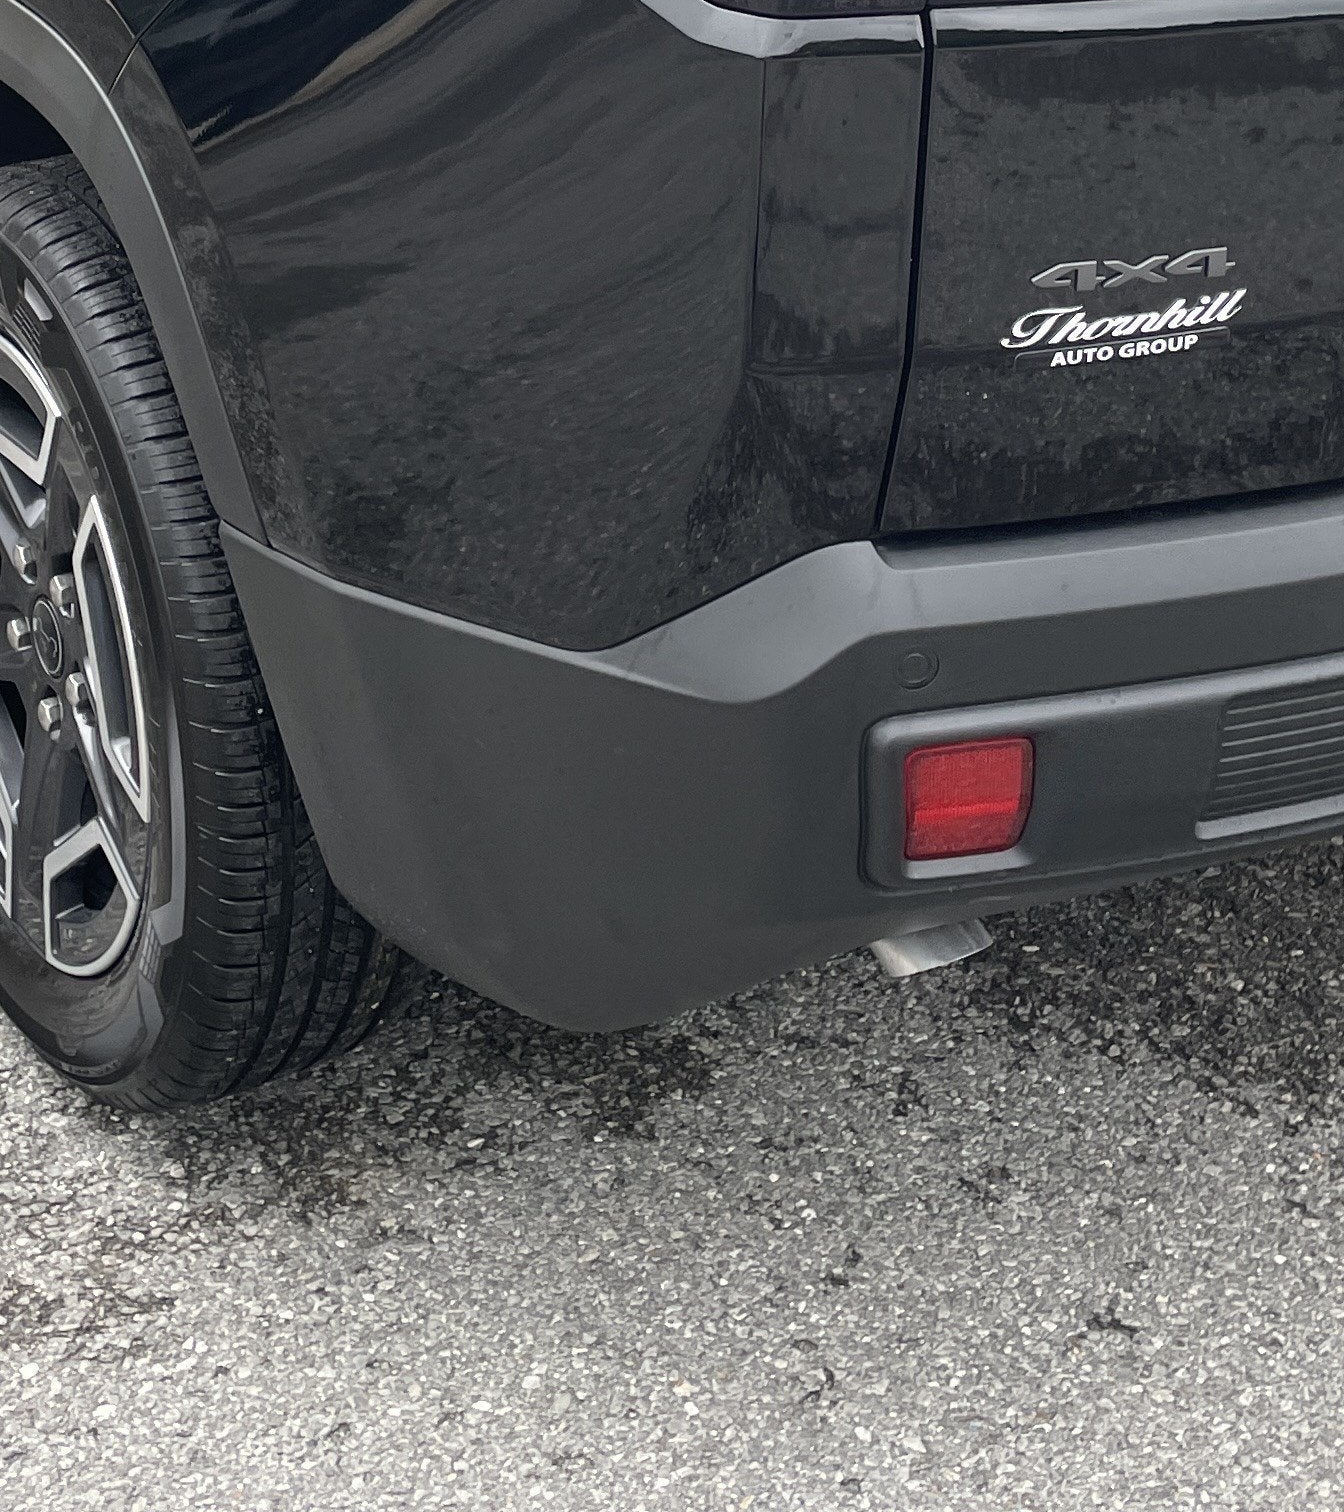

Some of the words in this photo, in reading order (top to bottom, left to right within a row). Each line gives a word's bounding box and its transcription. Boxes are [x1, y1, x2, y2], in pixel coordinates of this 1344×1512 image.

[999, 287, 1248, 350] Thornhill
[1049, 345, 1115, 369] AUTO
[1118, 334, 1199, 359] GROUP
